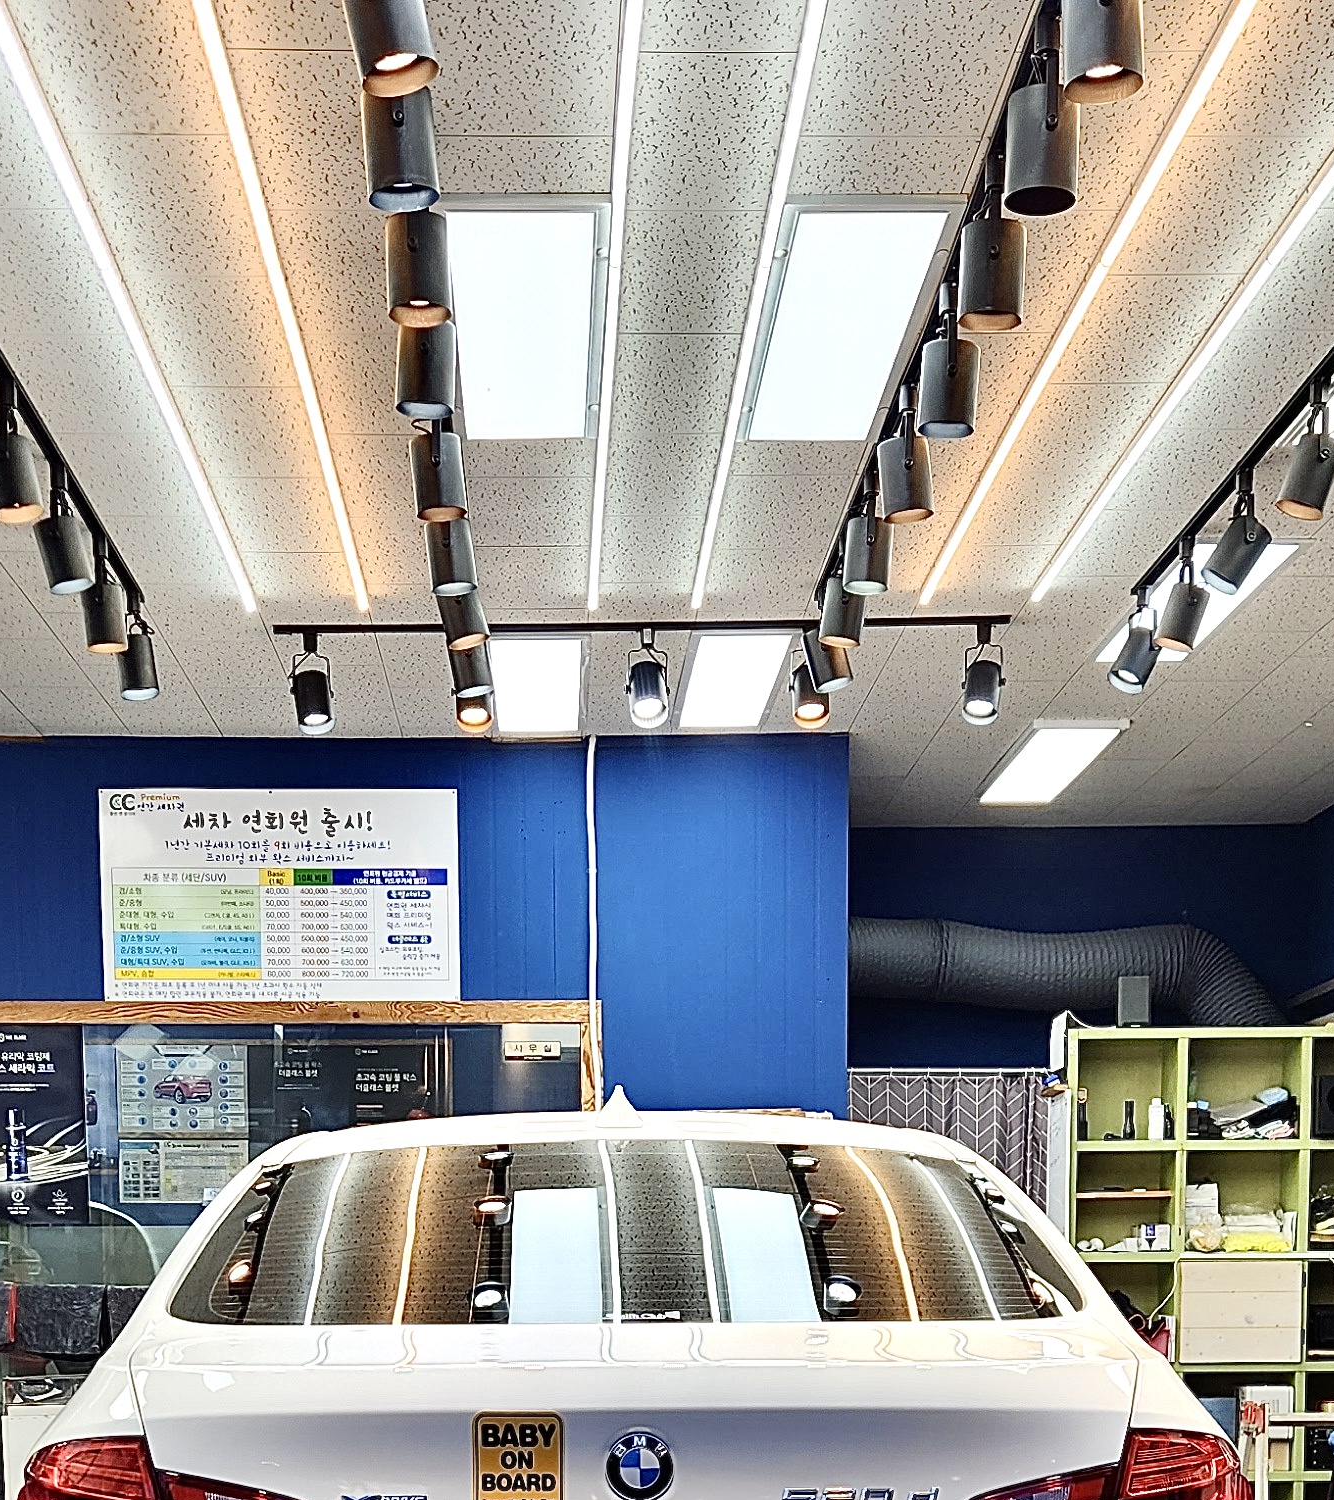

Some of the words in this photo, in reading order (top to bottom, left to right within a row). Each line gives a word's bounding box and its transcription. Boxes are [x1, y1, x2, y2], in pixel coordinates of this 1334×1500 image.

[140, 793, 181, 802] Premium
[183, 810, 231, 831] 세차
[243, 809, 308, 834] 연회원
[321, 807, 373, 837] 출시!
[194, 840, 235, 851] 기본세차
[274, 840, 290, 850] 9회
[206, 854, 244, 865] 프리미엄
[143, 873, 159, 883] 차종
[181, 872, 227, 883] (세단/SUV)
[267, 870, 286, 878] Basic
[1, 1052, 25, 1062] 유리막
[8, 1063, 36, 1074] 세라믹
[356, 1073, 377, 1082] 초고속
[356, 1083, 383, 1092] 더클래스
[481, 1423, 556, 1447] BABY
[613, 1436, 668, 1457] BMW
[500, 1450, 534, 1469] ON
[481, 1473, 556, 1491] BOARD
